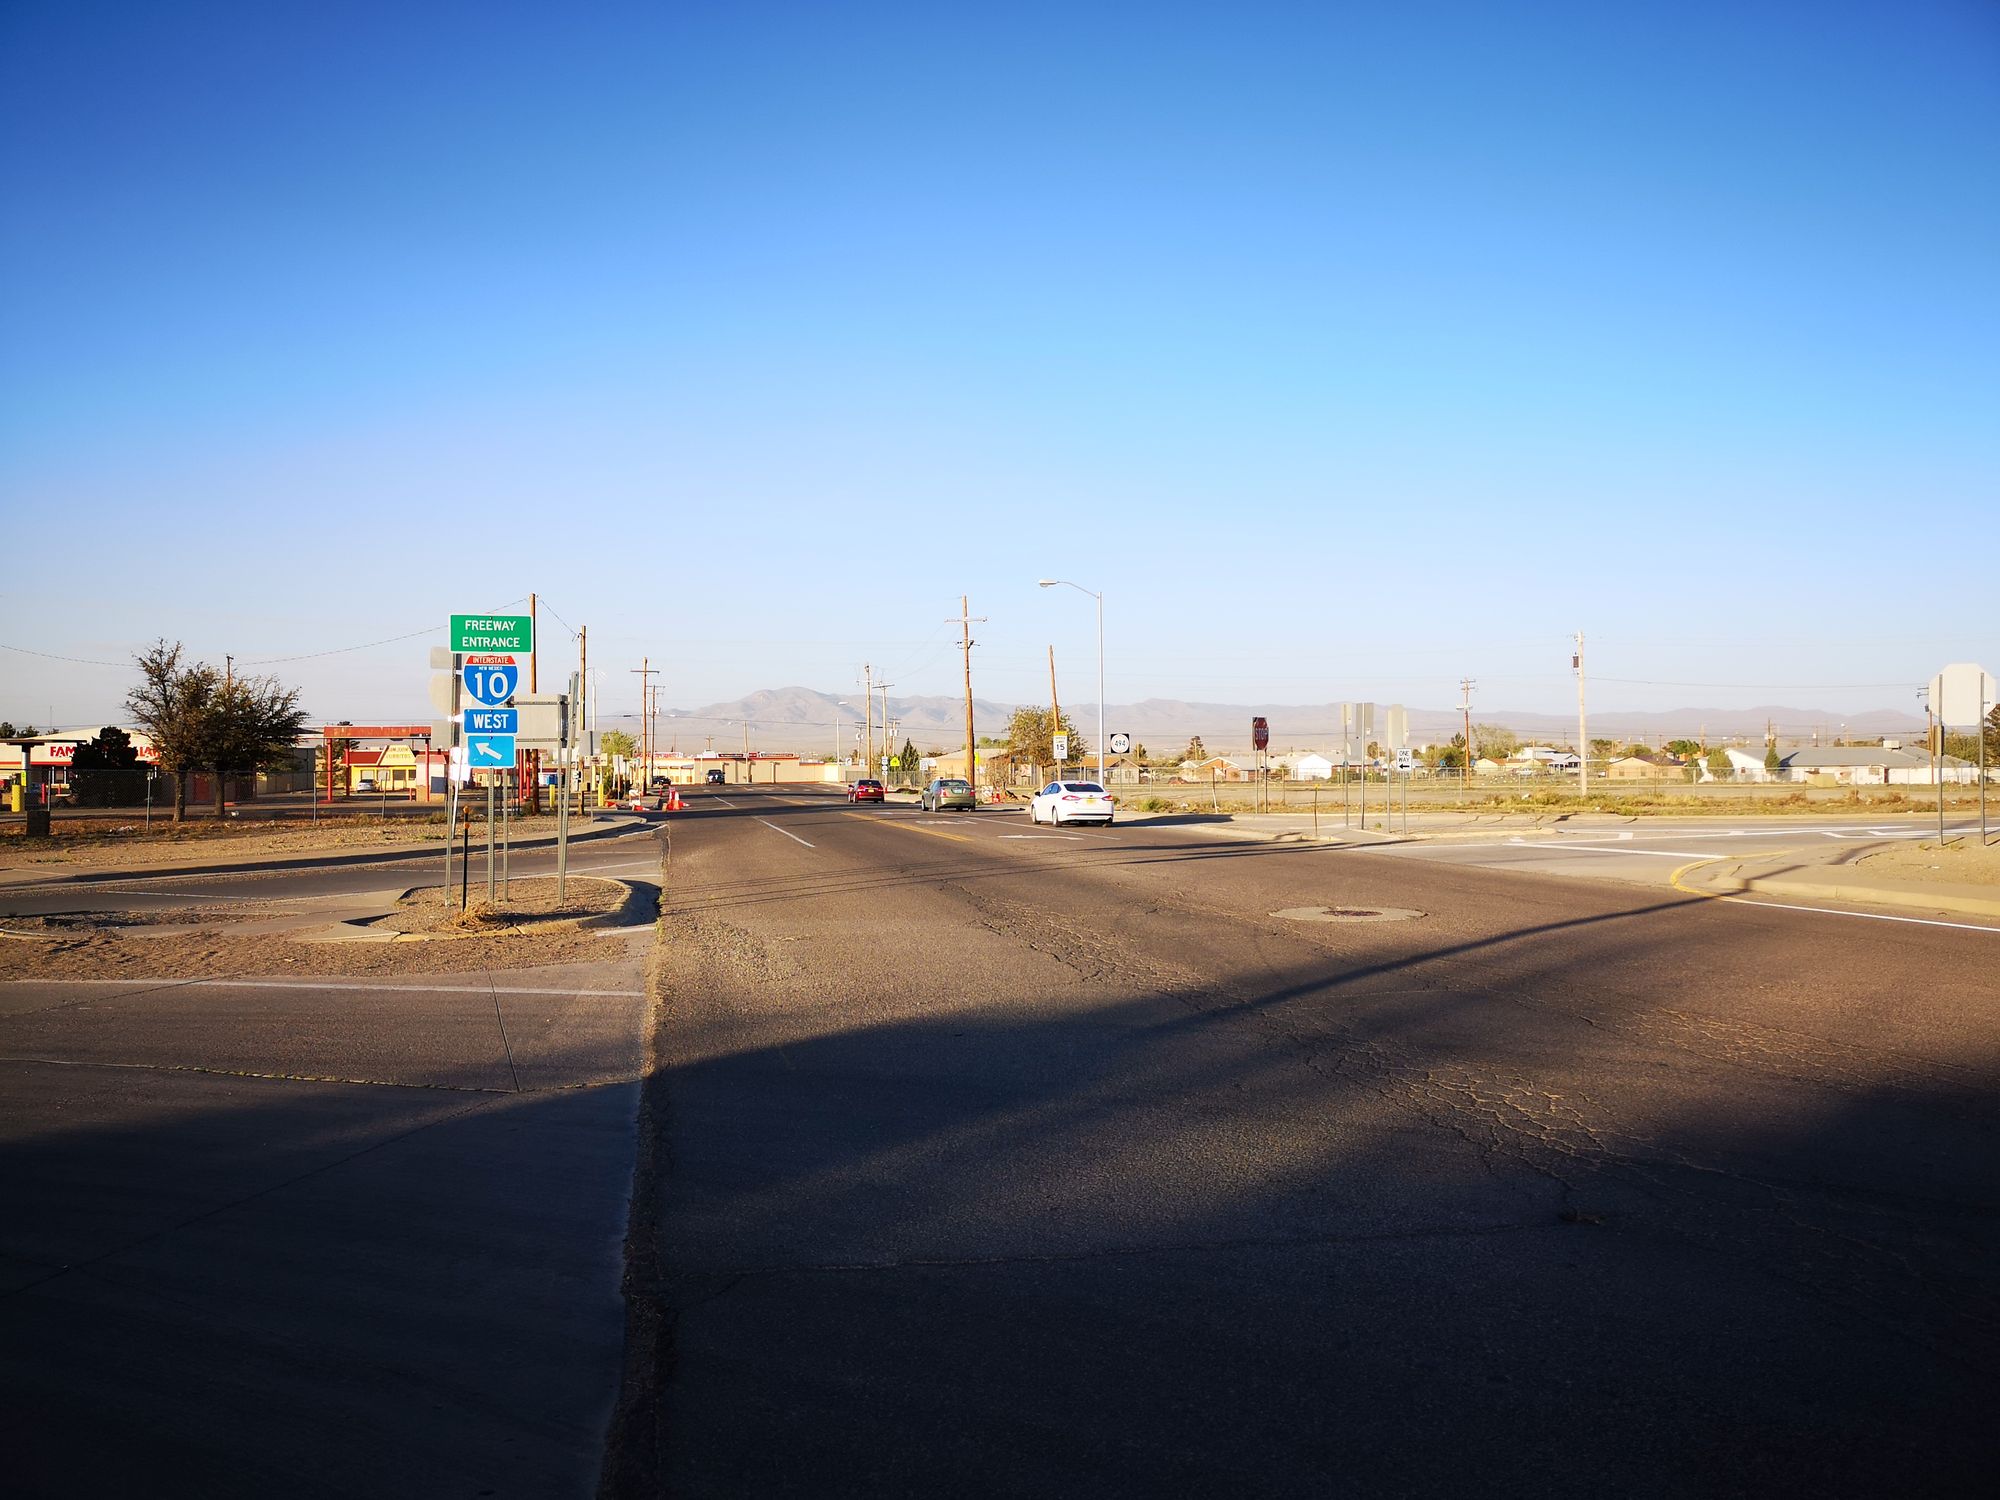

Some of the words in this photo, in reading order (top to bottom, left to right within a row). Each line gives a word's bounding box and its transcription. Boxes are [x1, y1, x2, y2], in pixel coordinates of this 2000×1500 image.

[465, 620, 516, 631] FREEWAY
[462, 636, 520, 647] ENTRANCE
[472, 656, 509, 664] INTERSTATE
[474, 672, 508, 699] 10
[473, 713, 509, 729] WEST
[1114, 739, 1126, 747] 494
[50, 746, 77, 757] FAM
